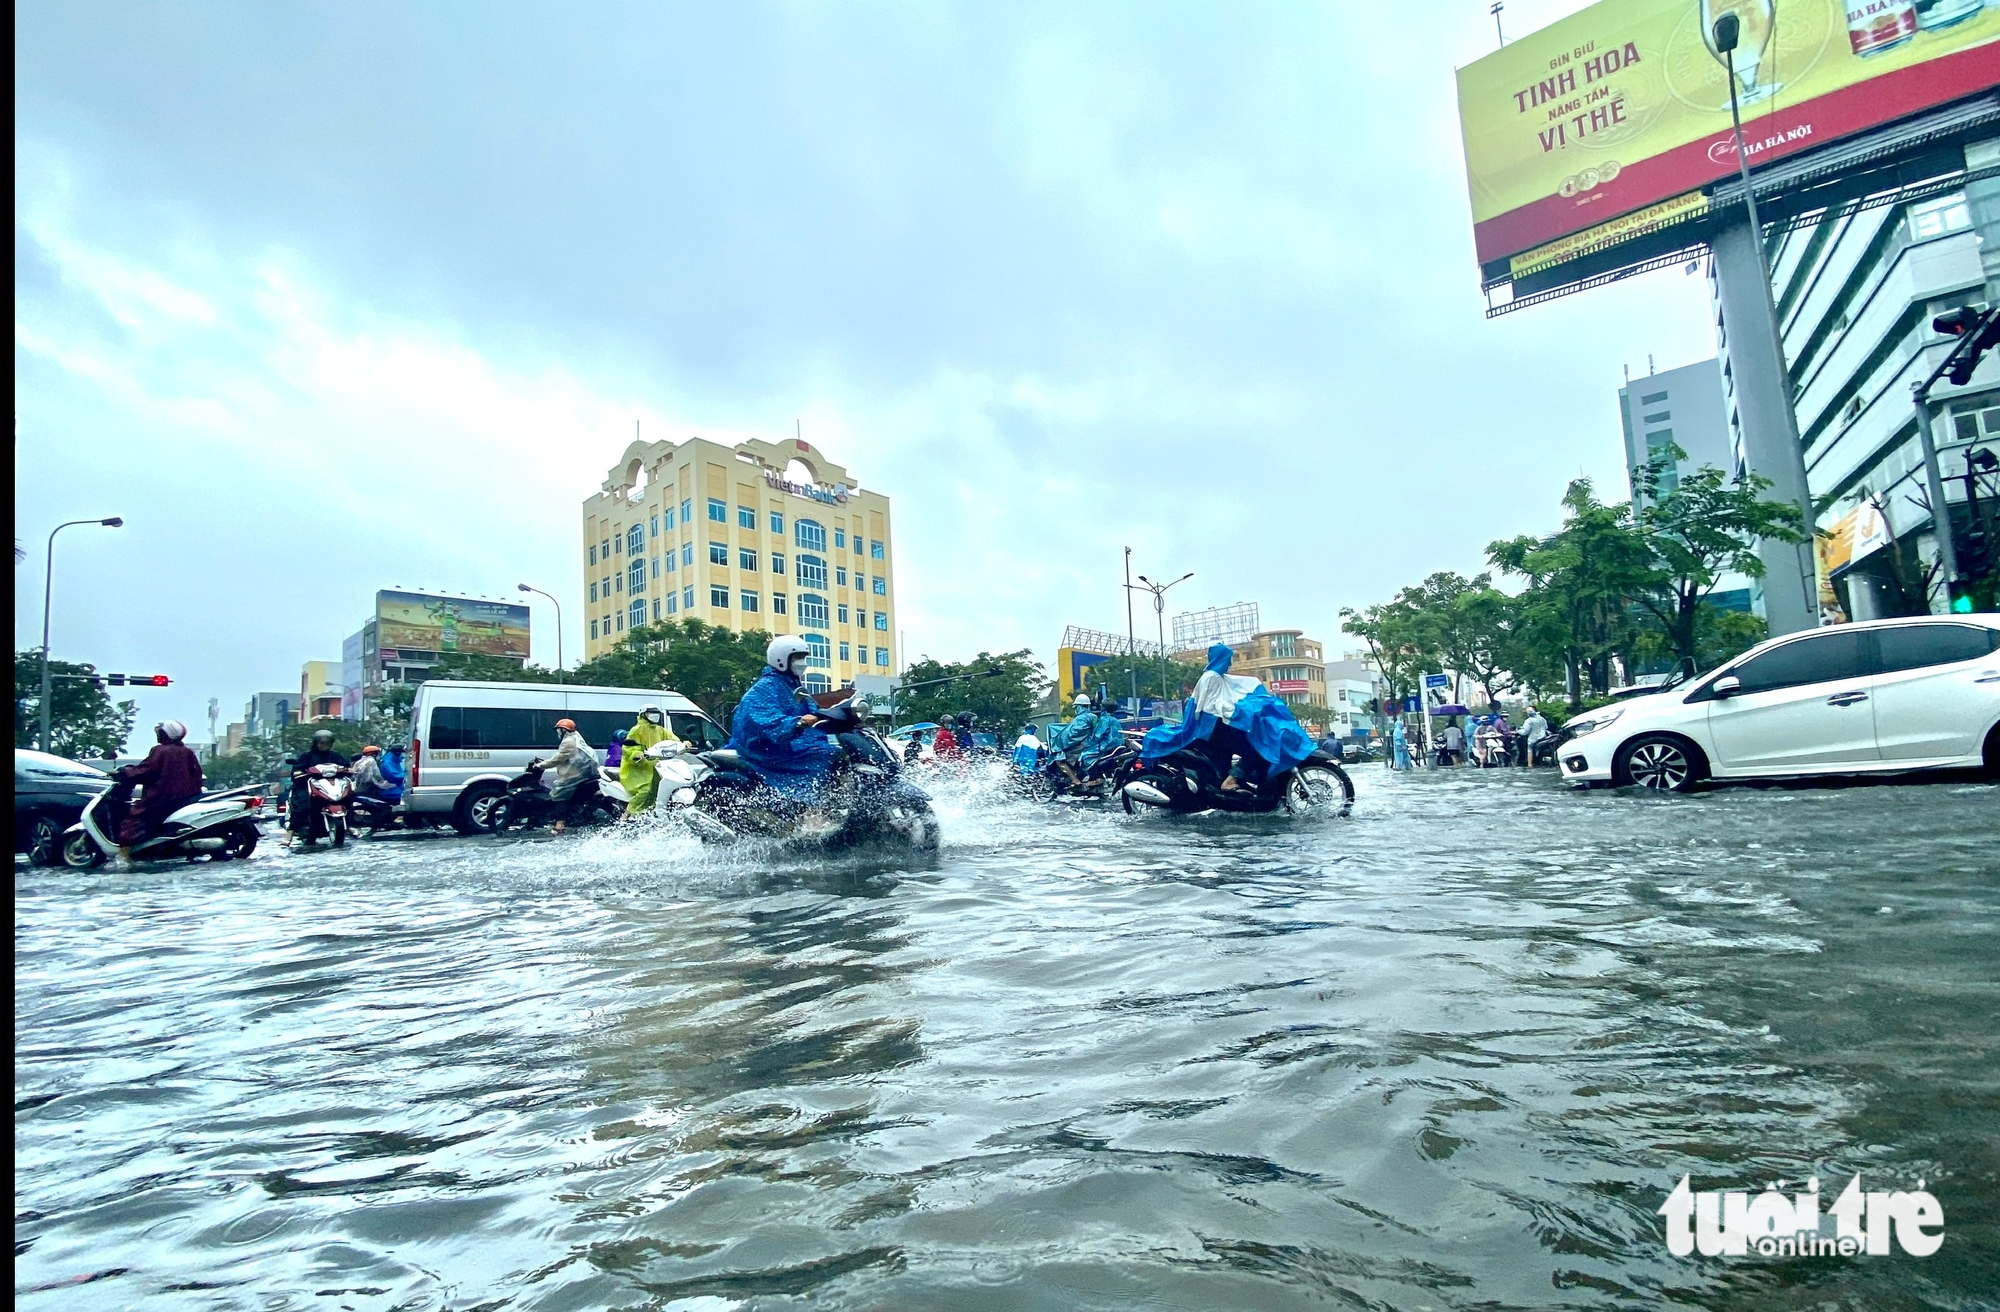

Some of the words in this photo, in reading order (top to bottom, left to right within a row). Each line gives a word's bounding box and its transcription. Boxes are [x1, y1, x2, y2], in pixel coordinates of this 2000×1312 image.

[1513, 68, 1576, 113] TINH
[1584, 41, 1641, 84] HOA
[1538, 123, 1566, 153] VỊ
[1572, 93, 1627, 139] THẾ
[1765, 131, 1786, 148] HÀ
[1787, 124, 1812, 142] NỘI
[1536, 240, 1572, 258] PHÒNG
[1573, 232, 1591, 245] BIA
[1592, 224, 1608, 238] HÀ
[1610, 217, 1629, 231] NỘI
